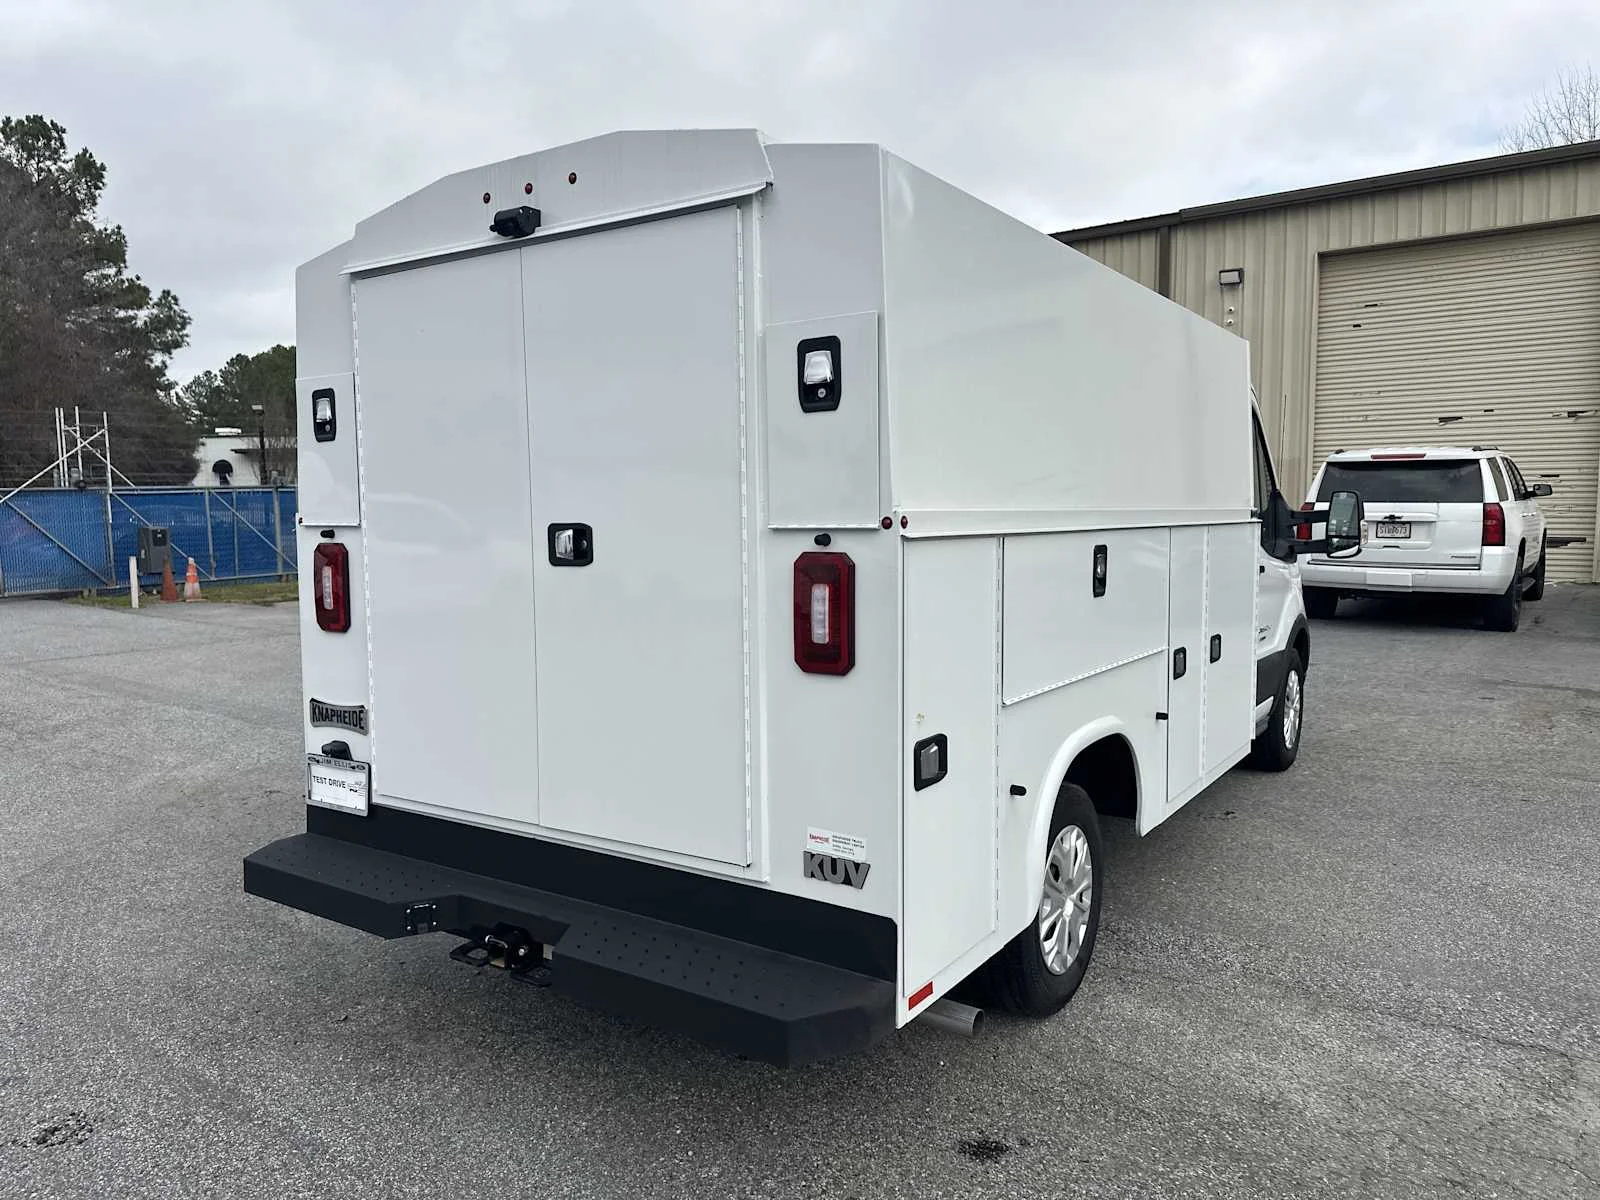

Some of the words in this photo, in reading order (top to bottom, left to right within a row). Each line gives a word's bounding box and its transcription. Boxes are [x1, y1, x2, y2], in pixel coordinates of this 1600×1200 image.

[311, 702, 365, 730] KNAPHEIDE
[312, 775, 327, 785] TEST
[328, 778, 346, 789] DRIVE
[803, 851, 871, 890] KUV
